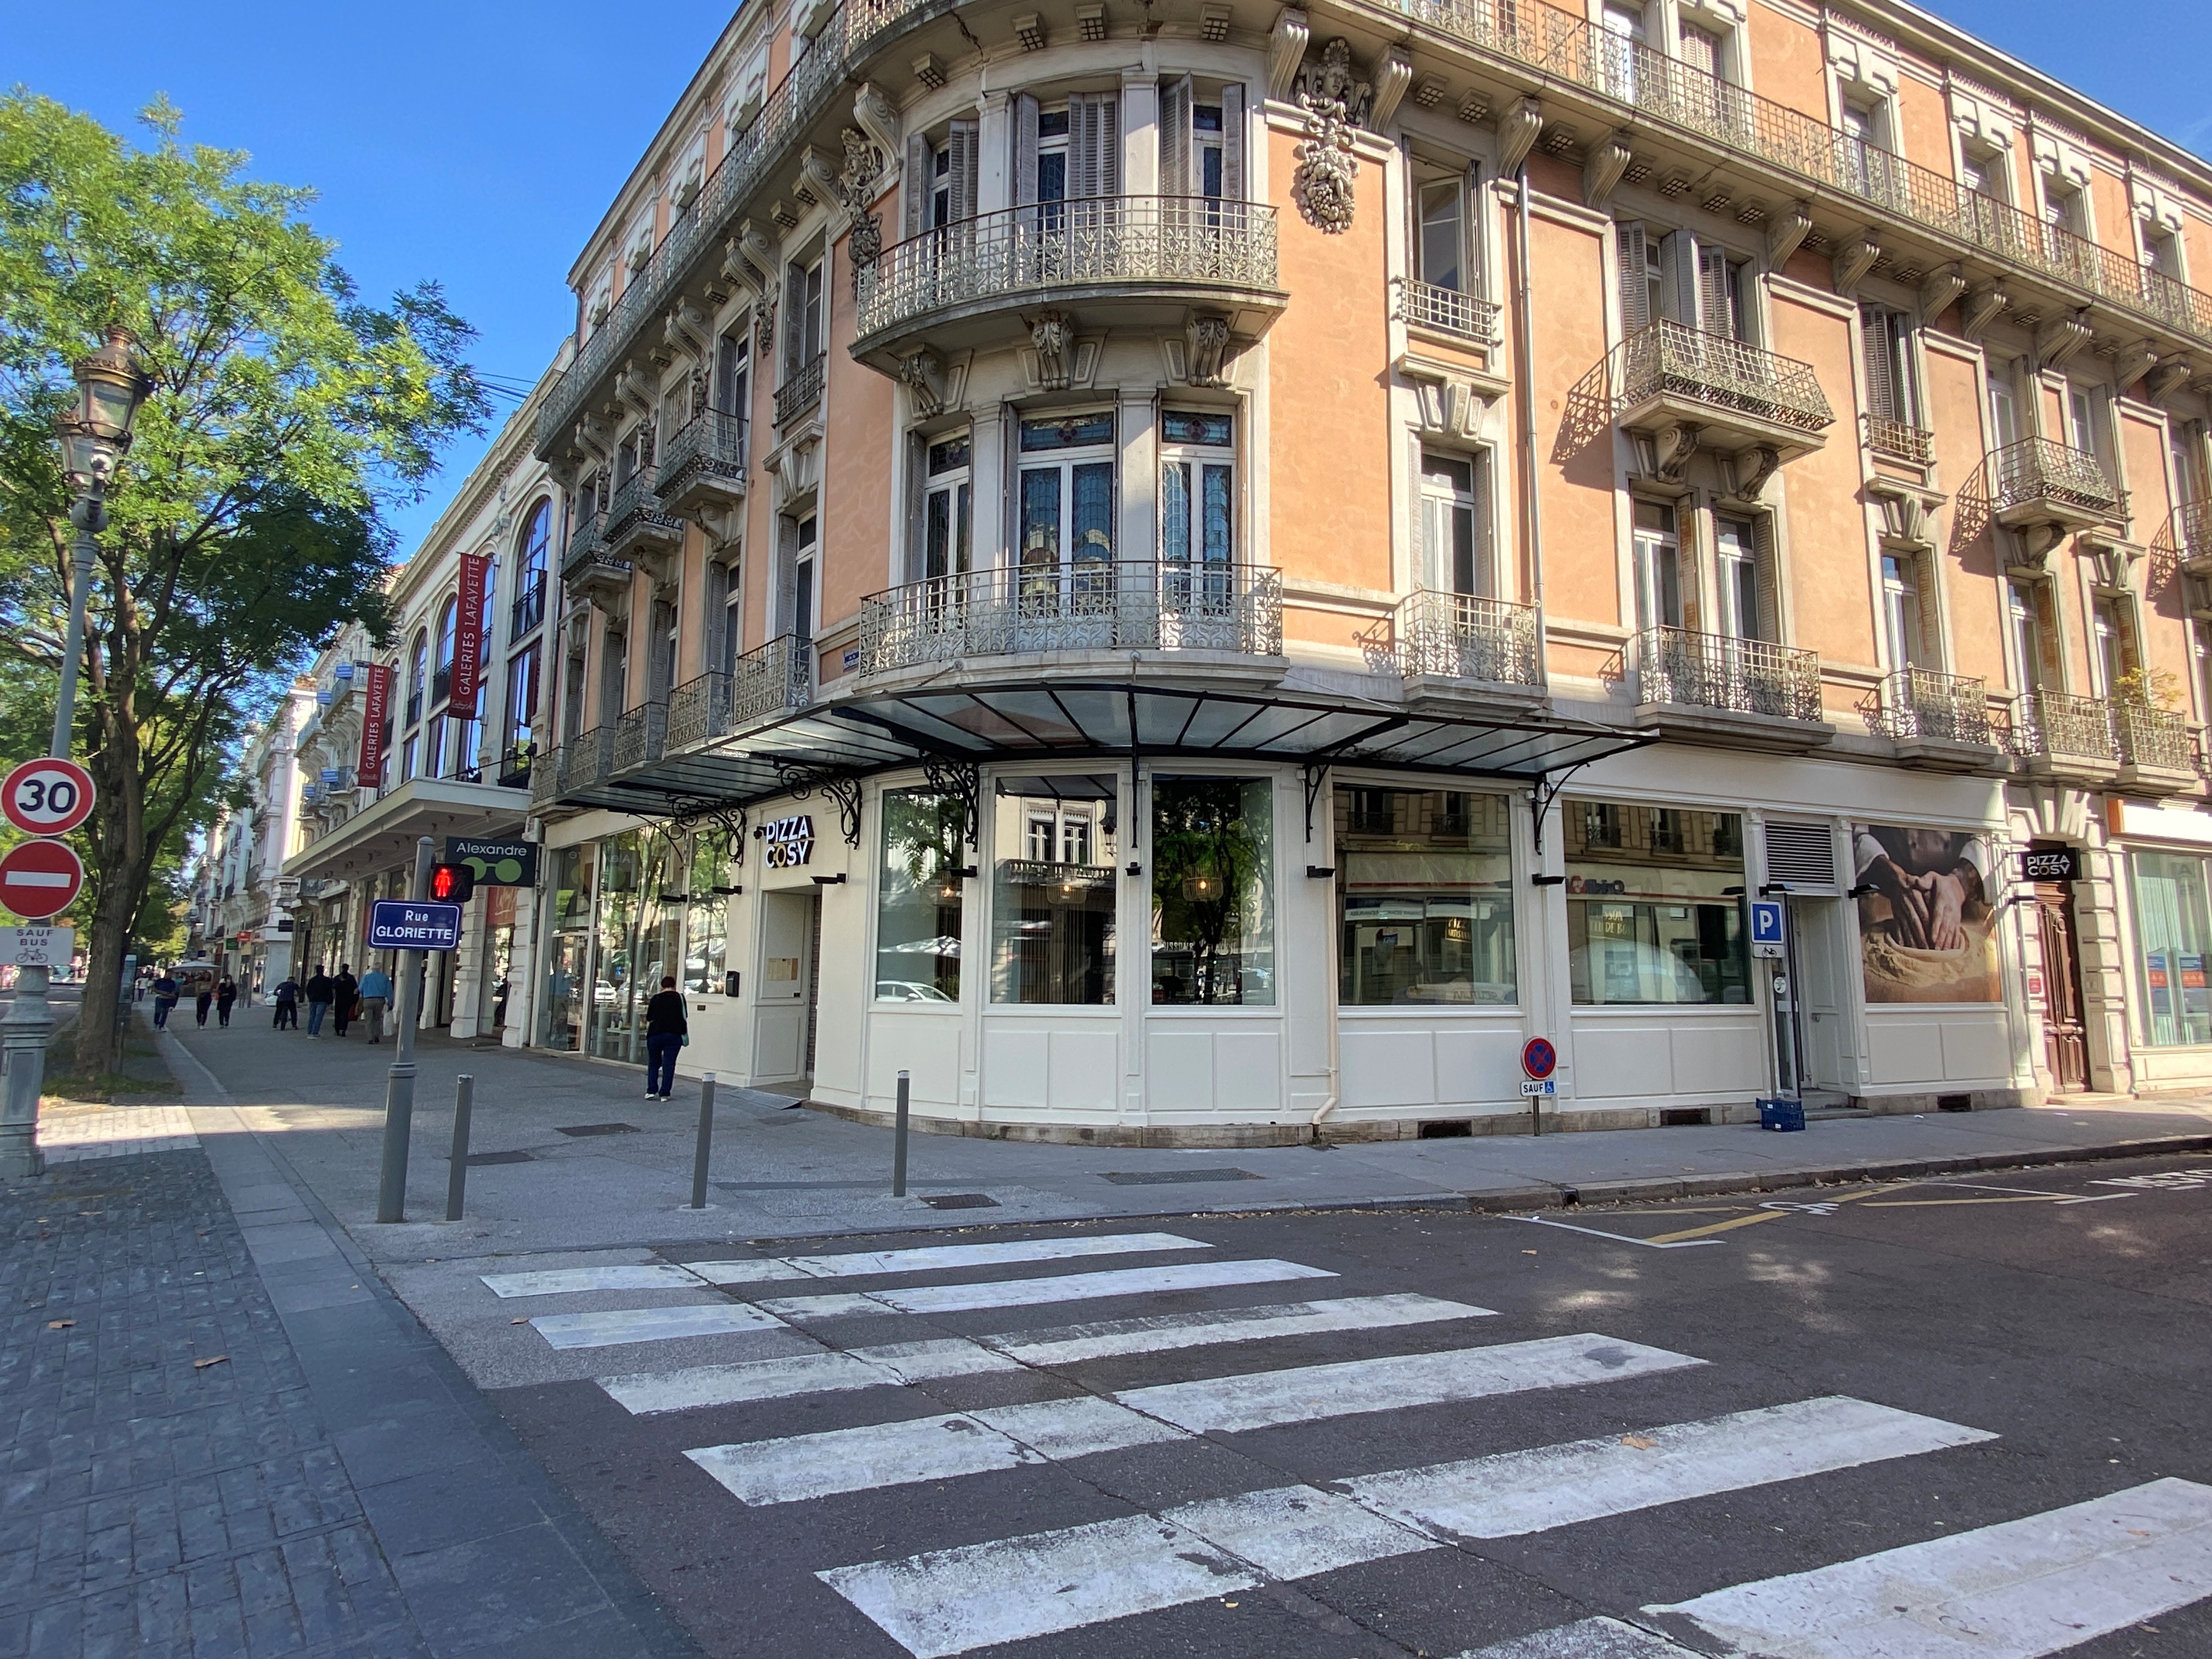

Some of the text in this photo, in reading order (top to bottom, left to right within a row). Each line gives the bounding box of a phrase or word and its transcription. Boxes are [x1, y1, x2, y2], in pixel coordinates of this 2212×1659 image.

[465, 557, 481, 626] LAFAYETTE
[459, 631, 474, 696] GALERIES
[371, 667, 384, 718] LAFAYETTE
[366, 722, 379, 769] GALERIES
[19, 779, 76, 814] 30
[766, 816, 810, 844] PIZZA
[456, 842, 527, 856] Alexandre
[765, 840, 809, 868] COSY
[2027, 855, 2071, 867] PIZZA
[2028, 864, 2071, 876] COSY
[405, 910, 428, 922] Rue
[1759, 910, 1773, 935] P
[376, 926, 453, 940] GLORIETTE
[1523, 1083, 1543, 1093] SAUF
